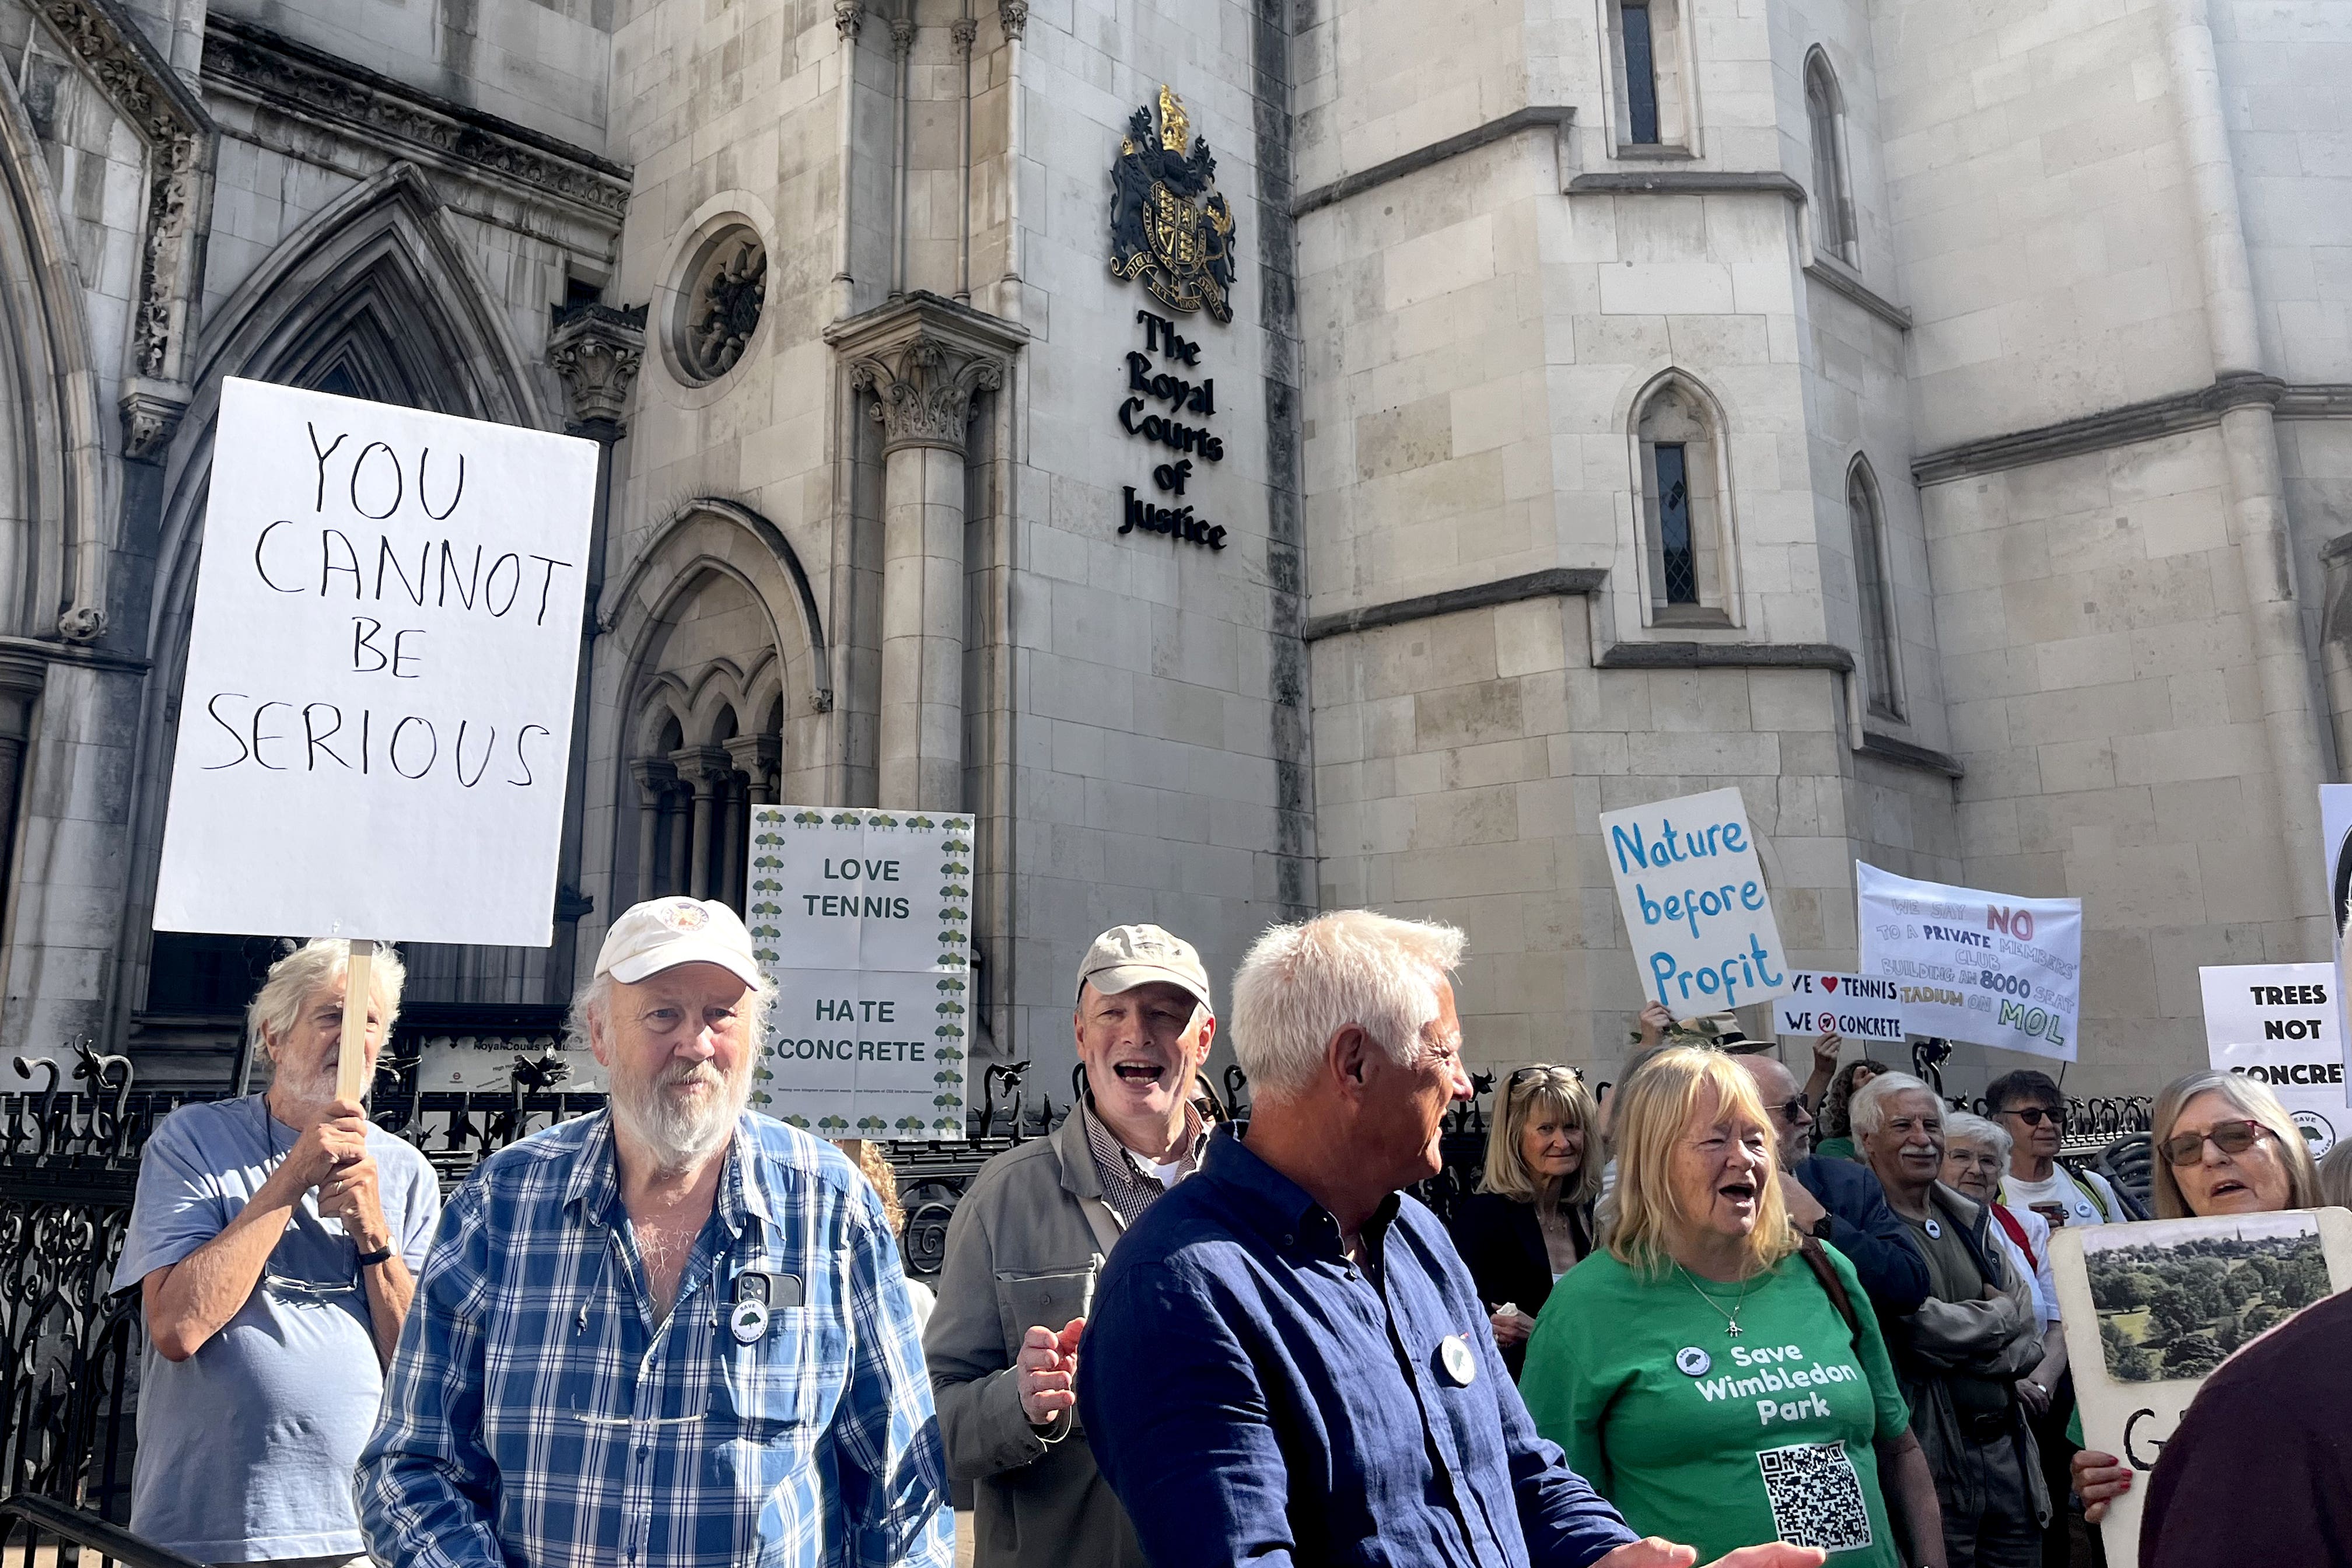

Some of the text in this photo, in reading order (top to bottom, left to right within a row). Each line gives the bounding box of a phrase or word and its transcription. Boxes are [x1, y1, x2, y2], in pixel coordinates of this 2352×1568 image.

[1138, 310, 1201, 366] The
[1126, 351, 1216, 415] Royal
[1119, 397, 1224, 461] Courts
[307, 421, 464, 521] YOU
[1154, 459, 1193, 495] of
[1118, 485, 1227, 551] Justice
[255, 520, 573, 626] CANNOT
[351, 616, 426, 678] BE
[200, 692, 550, 788] SERIOUS
[1612, 818, 1747, 874] Nature
[824, 858, 900, 881] LOVE
[803, 894, 909, 919] TENNIS
[1636, 881, 1765, 939] before
[1892, 899, 2033, 941] WE SAY NO
[1876, 925, 1901, 941] TO
[1907, 925, 1919, 939] A
[1923, 925, 1991, 949] PRIVATE
[1650, 933, 1783, 1007] Profit
[1955, 949, 2001, 971] CLUB
[1842, 978, 1897, 999] TENNIS
[1881, 958, 1955, 982] BUILDING
[1980, 970, 2031, 998] 8000
[2034, 986, 2074, 1014] SEAT
[2250, 984, 2328, 1006] TREES
[816, 999, 895, 1023] HATE
[1785, 1012, 1901, 1037] WE CONCRETE
[1900, 986, 2065, 1046] TADIUM ON MOL
[2264, 1020, 2323, 1040] NOT
[777, 1038, 925, 1062] CONCRETE
[2230, 1063, 2344, 1085] ONCRE
[740, 1303, 756, 1311] SAVE
[1730, 1344, 1803, 1367] Save
[1695, 1362, 1858, 1402] Wimbledon
[1756, 1391, 1831, 1426] Park
